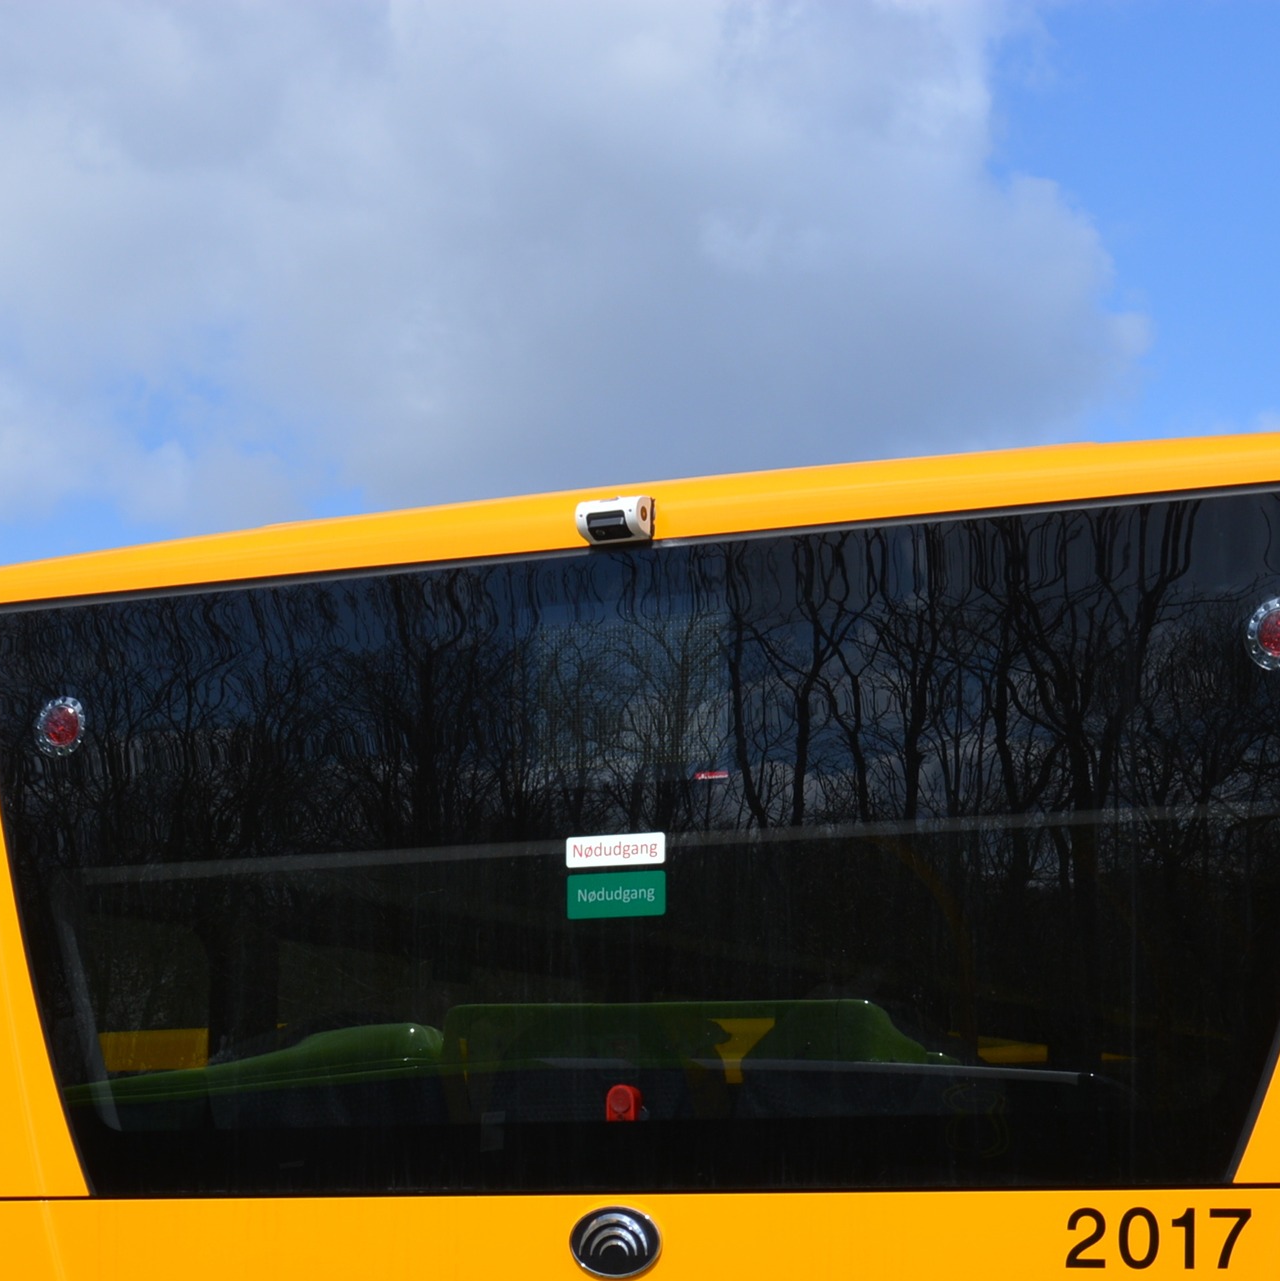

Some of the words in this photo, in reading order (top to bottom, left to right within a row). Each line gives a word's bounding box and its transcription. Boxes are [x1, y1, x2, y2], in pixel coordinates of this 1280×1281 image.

[572, 841, 658, 859] Nødudgang
[577, 886, 655, 903] Nødudgang
[1065, 1206, 1252, 1270] 2017
